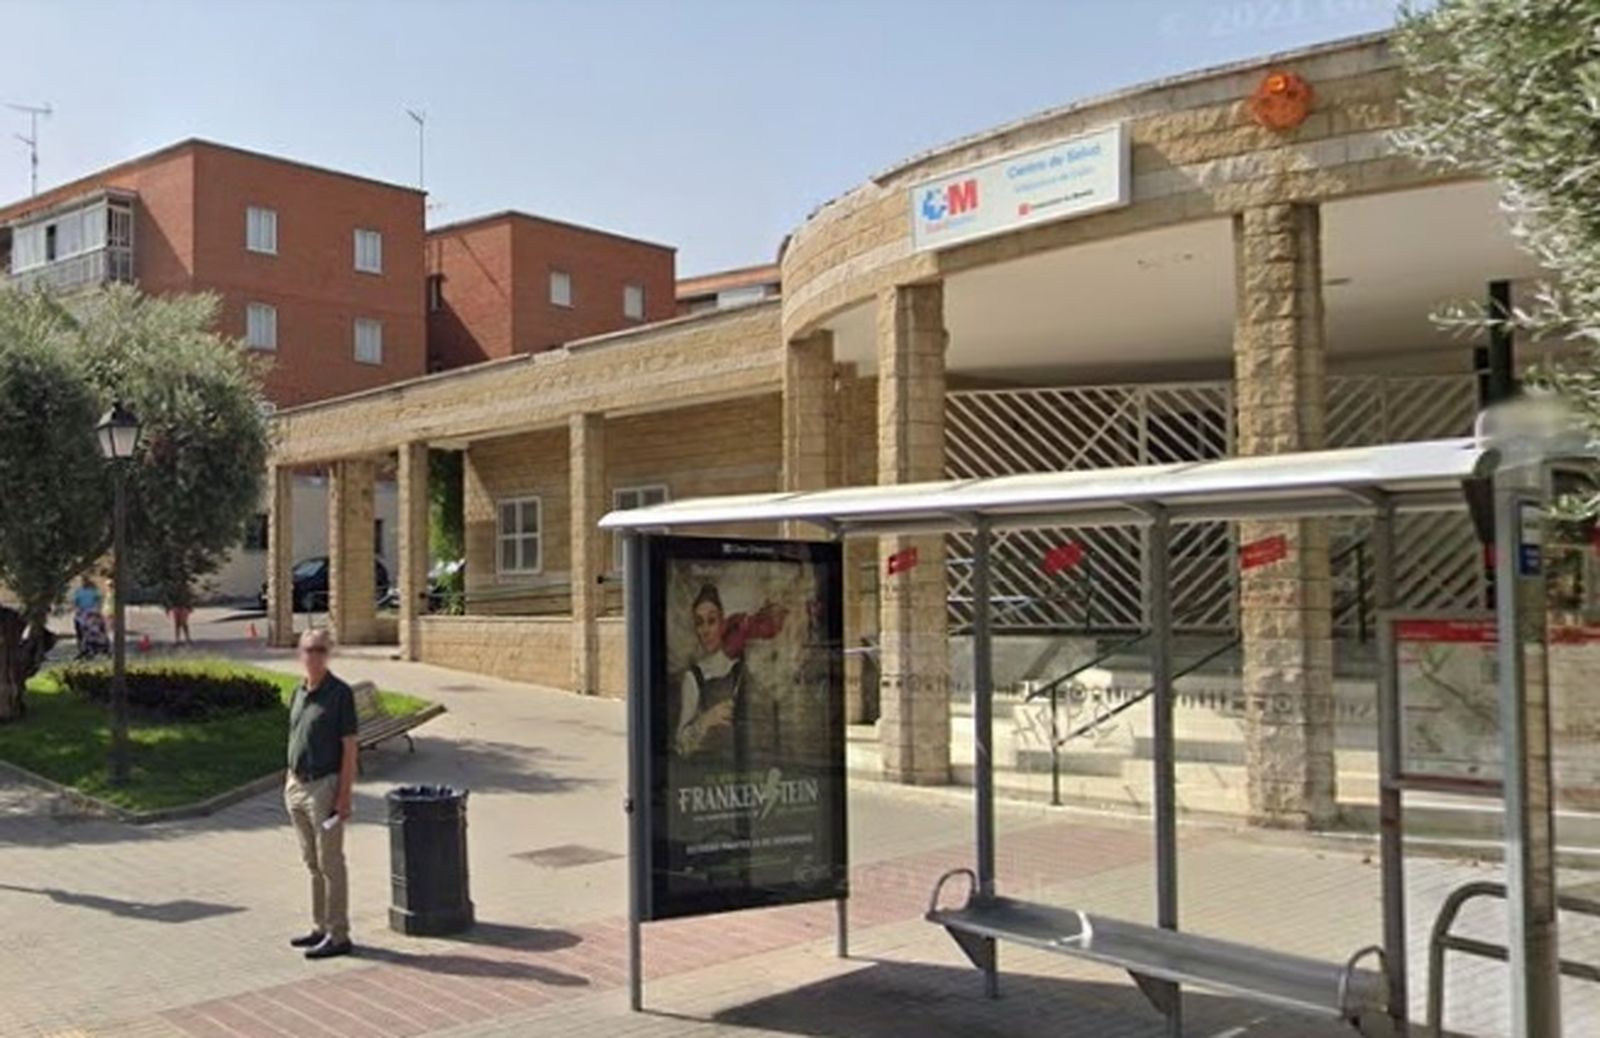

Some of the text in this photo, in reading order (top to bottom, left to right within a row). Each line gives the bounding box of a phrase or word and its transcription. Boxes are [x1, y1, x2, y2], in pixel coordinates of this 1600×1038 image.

[1006, 143, 1101, 179] Centro de Salud
[678, 770, 821, 816] FRANKENSTEIN
